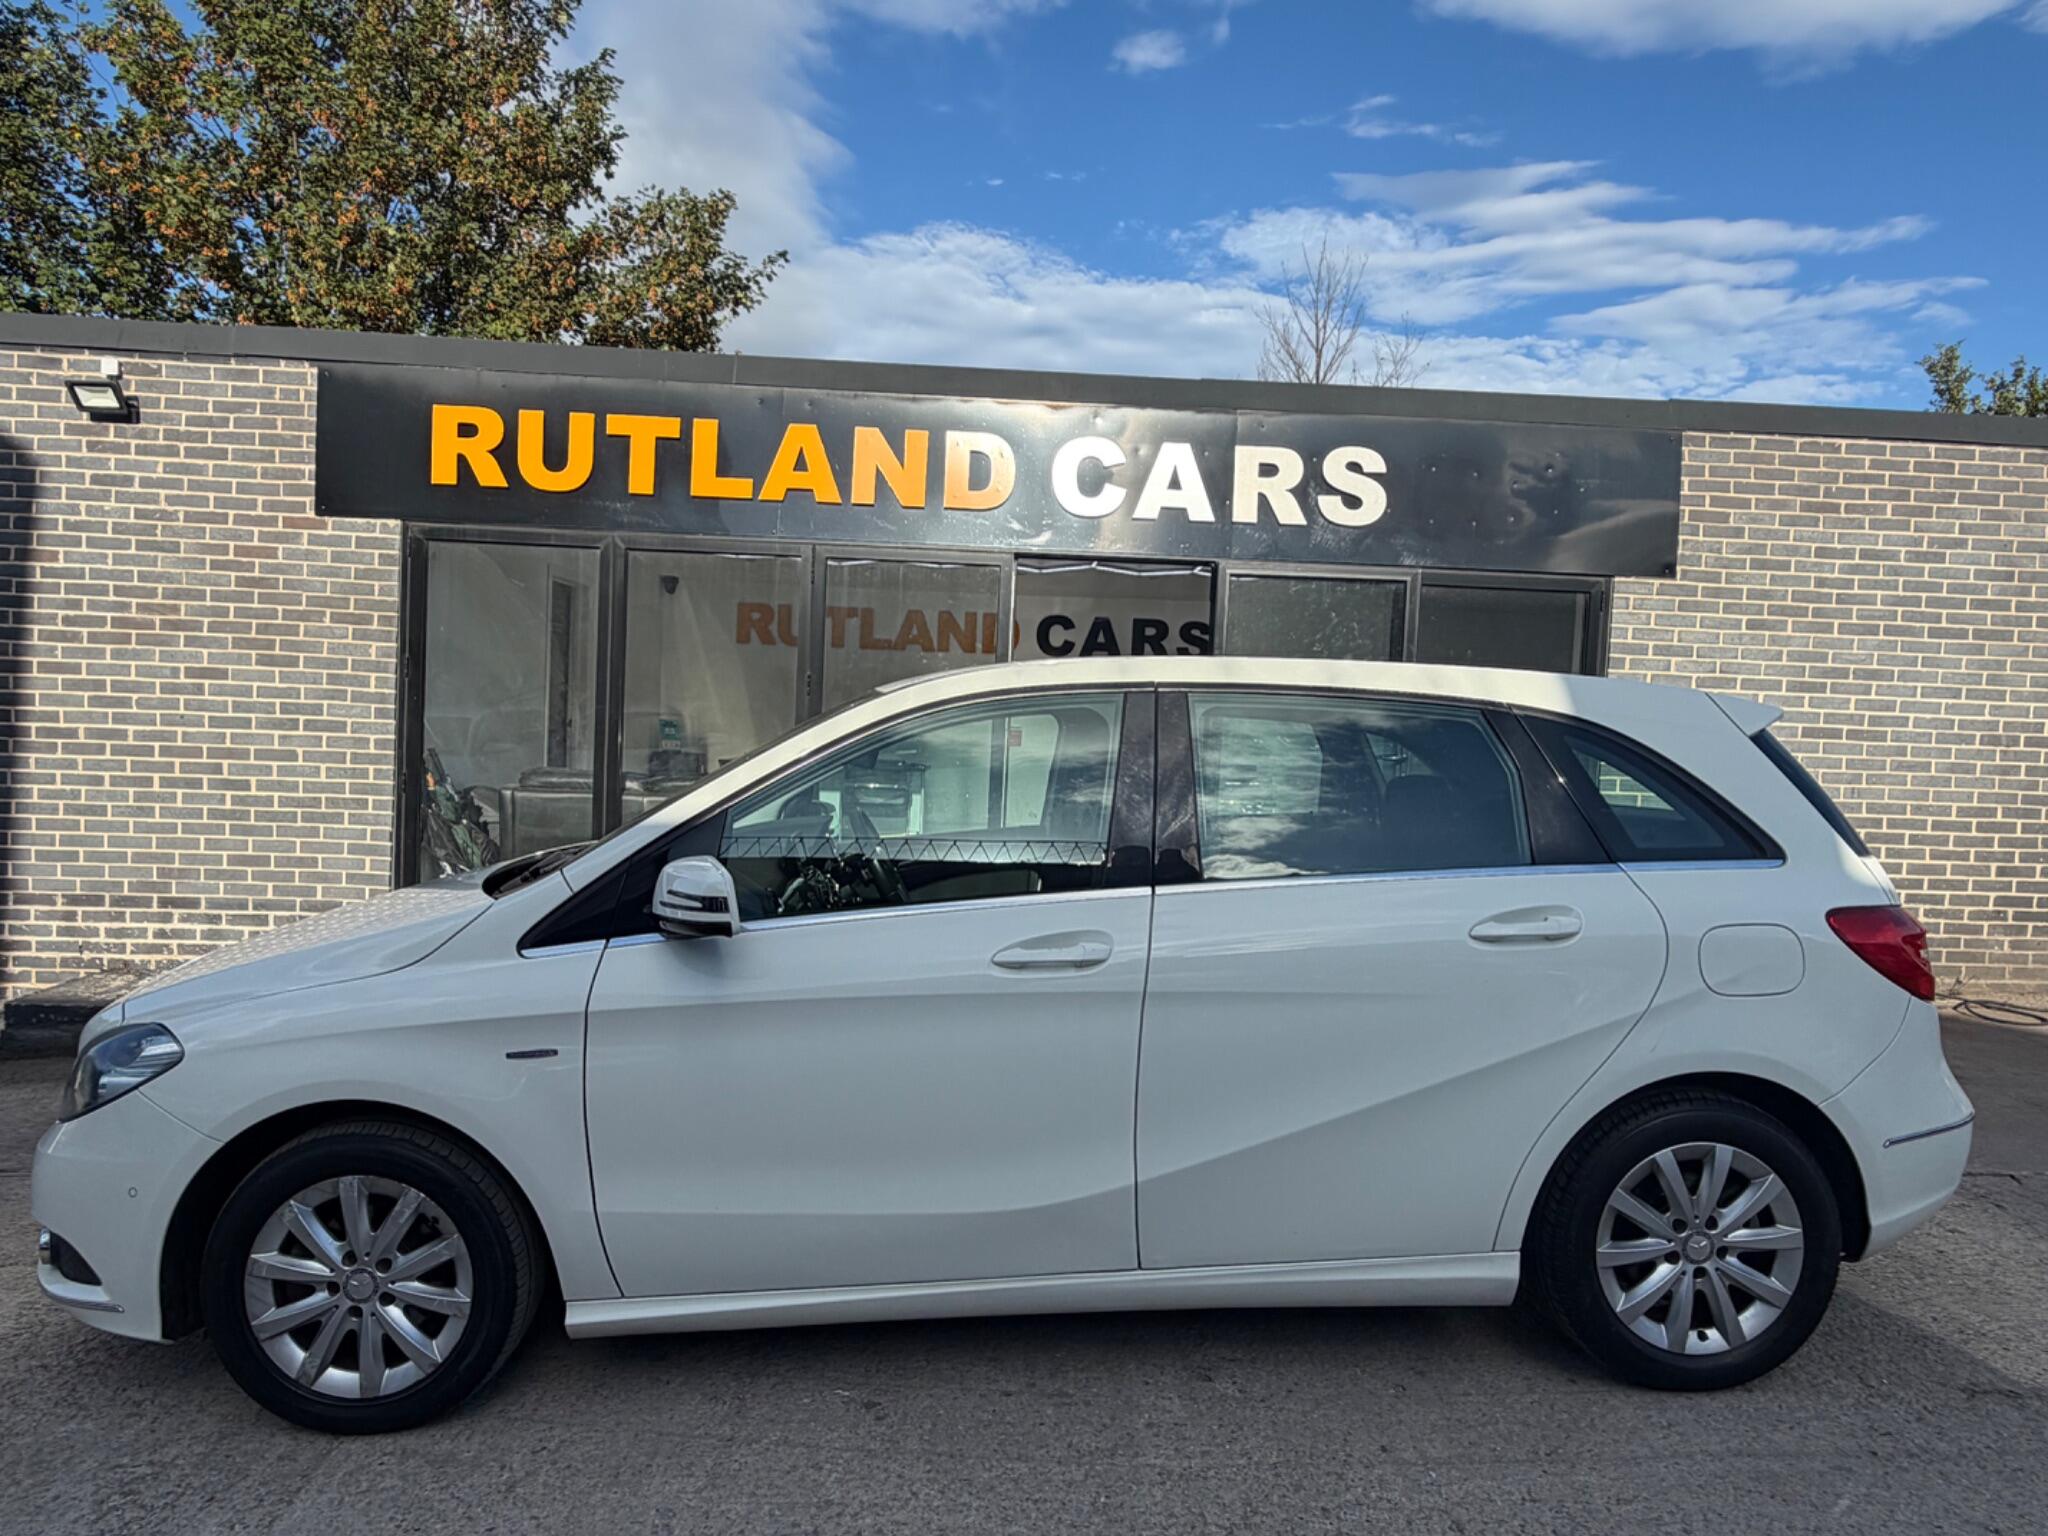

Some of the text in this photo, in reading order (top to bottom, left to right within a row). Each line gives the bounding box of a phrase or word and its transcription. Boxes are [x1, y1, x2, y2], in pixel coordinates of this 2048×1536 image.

[430, 403, 1388, 527] RUTLAND CARS
[1036, 614, 1214, 657] CARS
